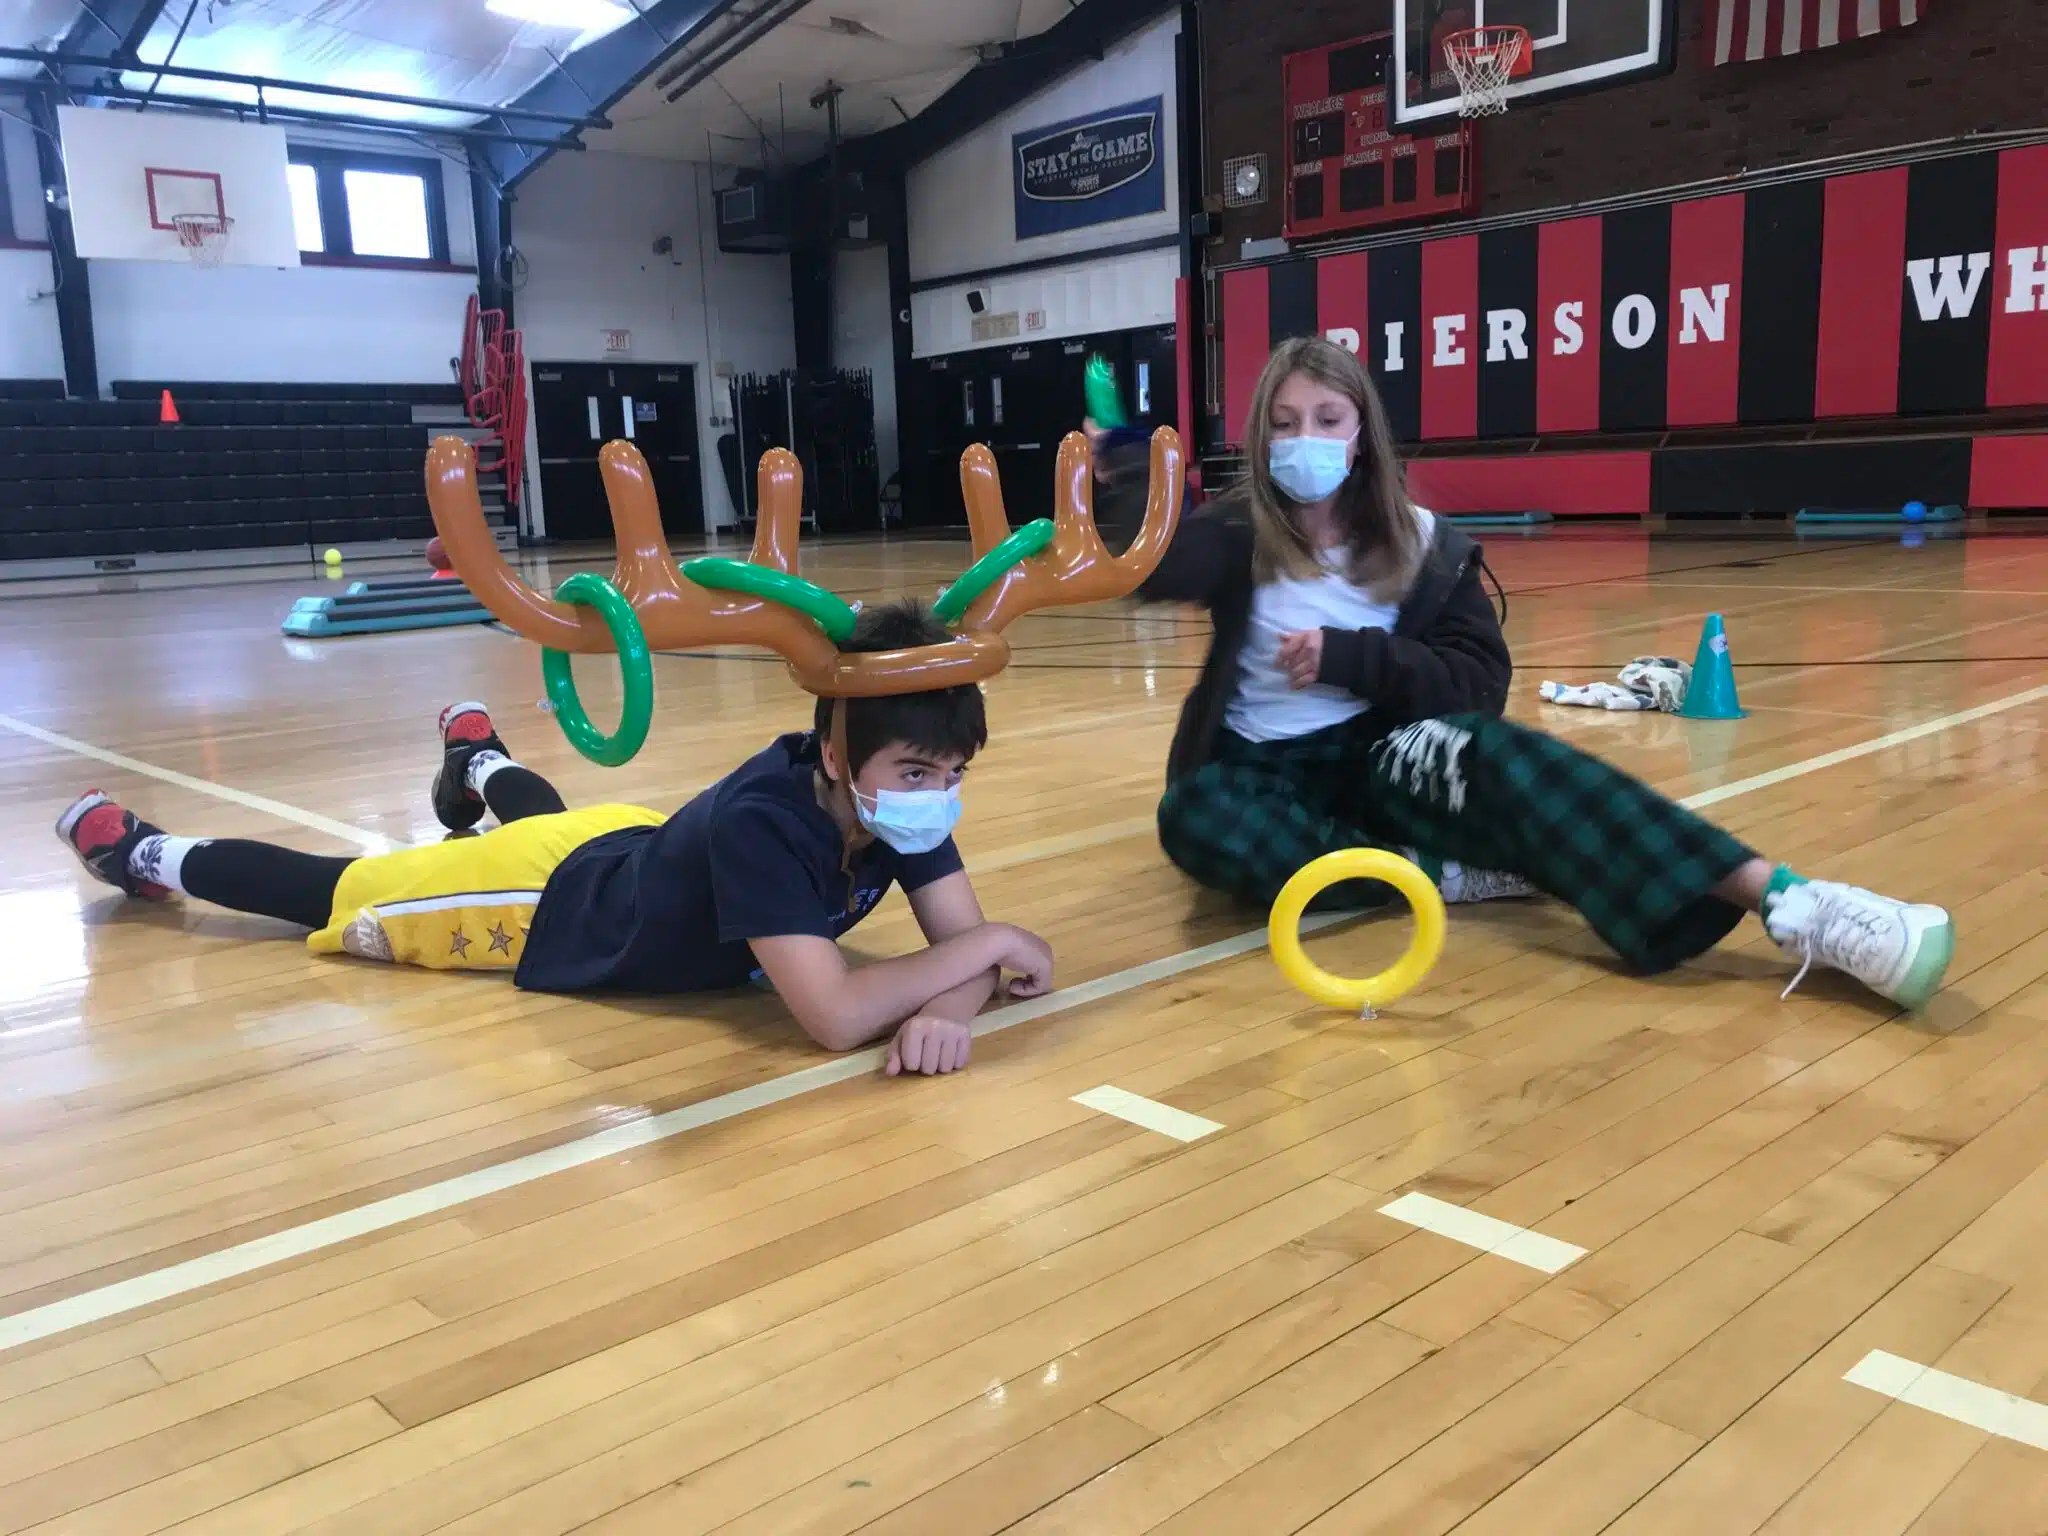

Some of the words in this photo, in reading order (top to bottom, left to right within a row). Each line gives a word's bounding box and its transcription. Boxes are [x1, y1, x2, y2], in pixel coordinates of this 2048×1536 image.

[1027, 152, 1069, 179] STAY
[1092, 132, 1147, 162] GAME
[1906, 245, 2048, 322] WH
[1027, 311, 1040, 328] EXIT
